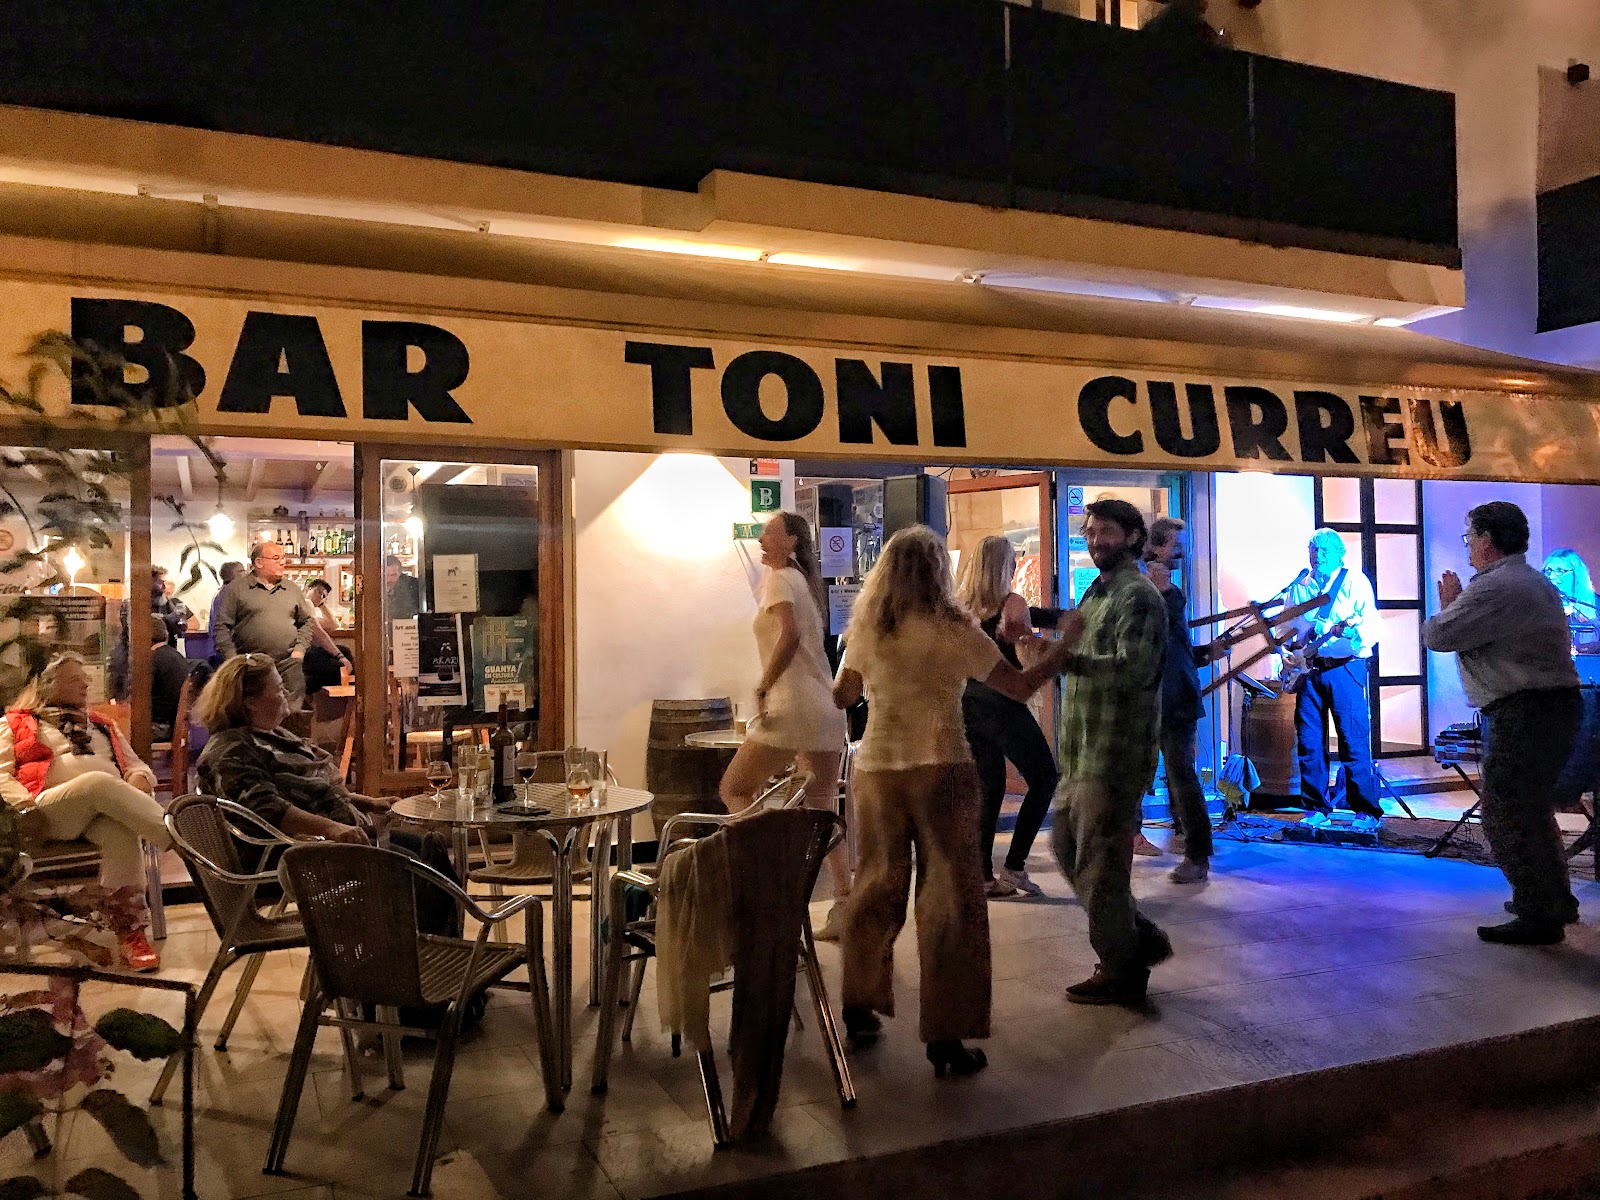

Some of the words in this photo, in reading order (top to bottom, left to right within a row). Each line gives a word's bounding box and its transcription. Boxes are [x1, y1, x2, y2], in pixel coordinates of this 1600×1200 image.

[71, 297, 473, 423] BAR
[625, 341, 966, 448] TONI
[1078, 375, 1471, 467] CURREU
[484, 664, 516, 673] GUANYA
